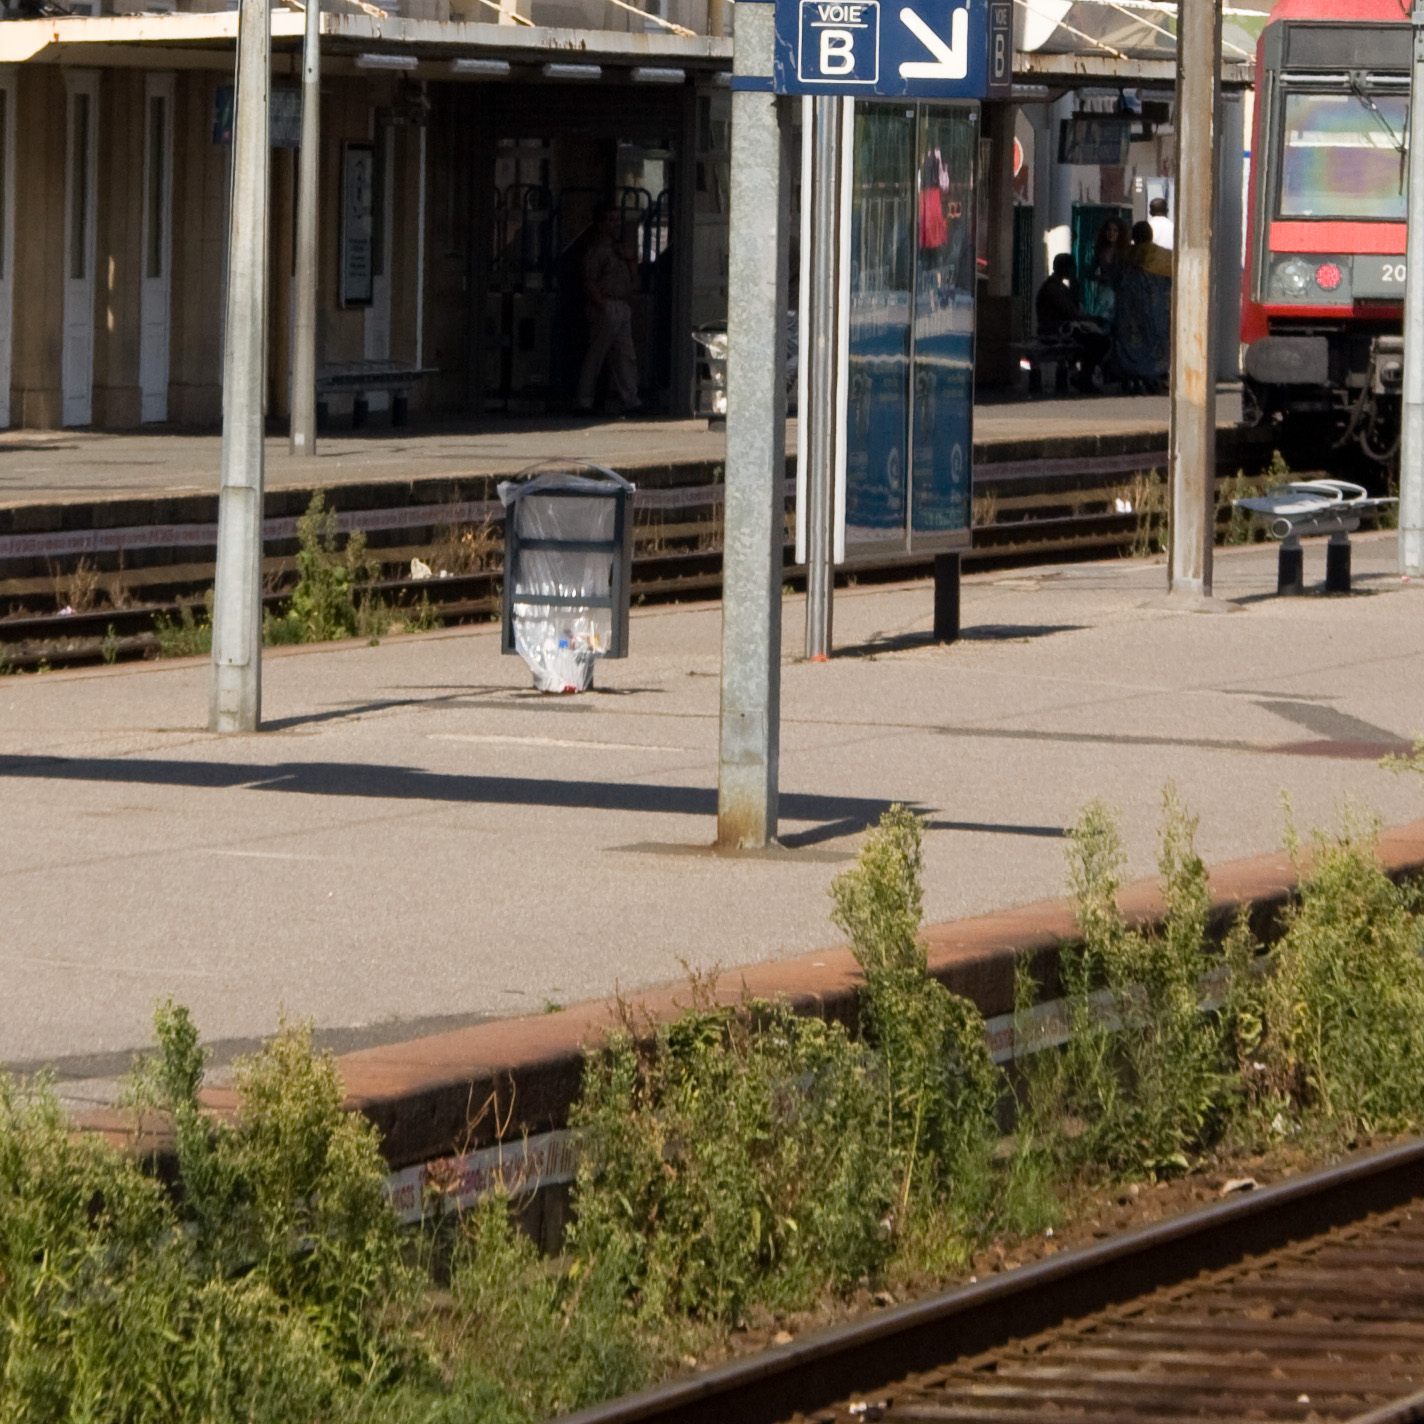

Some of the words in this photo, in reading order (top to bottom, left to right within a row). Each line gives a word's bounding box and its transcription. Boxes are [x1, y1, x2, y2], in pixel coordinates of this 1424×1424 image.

[817, 4, 863, 23] VOIE
[820, 29, 855, 75] B
[995, 34, 1006, 79] B
